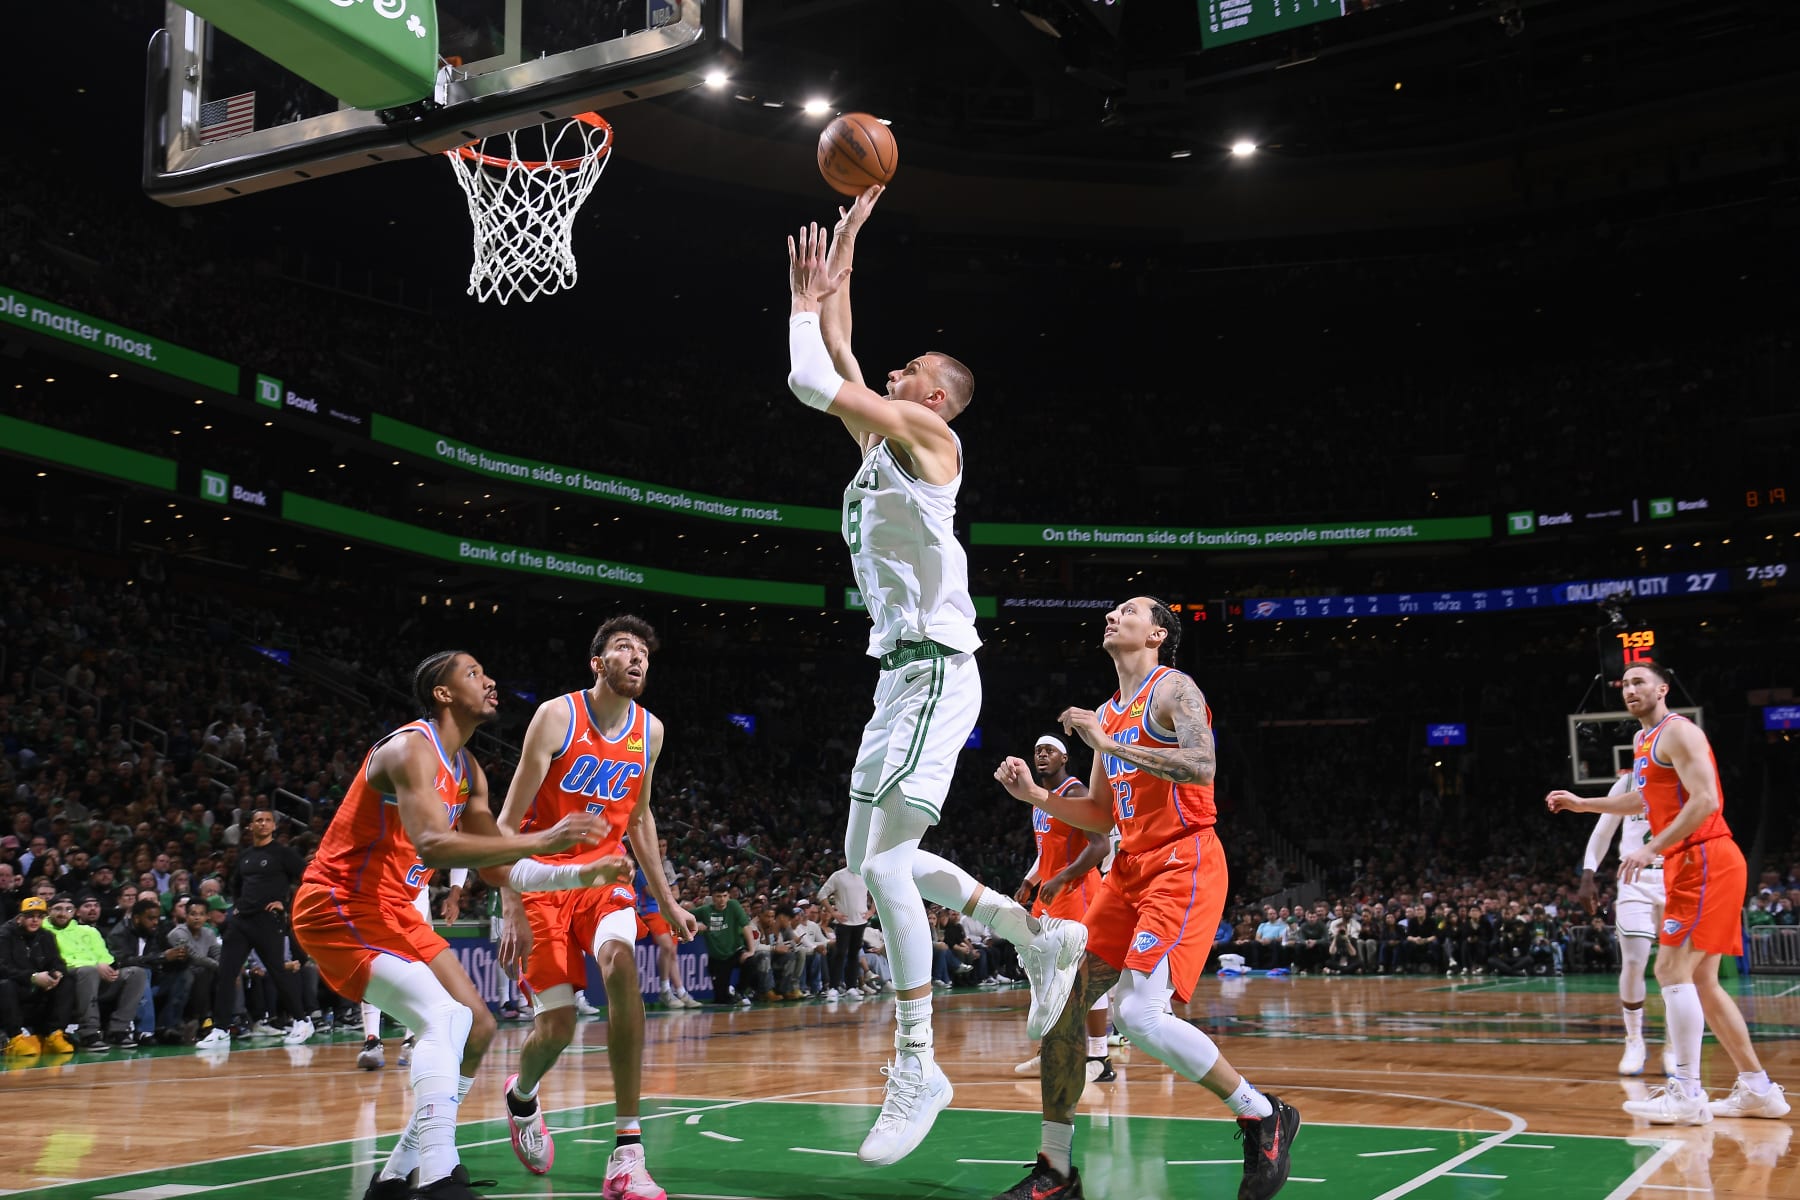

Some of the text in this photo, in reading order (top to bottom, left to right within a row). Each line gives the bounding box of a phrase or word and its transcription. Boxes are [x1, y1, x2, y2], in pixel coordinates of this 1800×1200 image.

[31, 307, 101, 342] matter
[104, 332, 157, 361] most.
[258, 379, 318, 413] TD Bank
[203, 475, 266, 506] TD Bank
[436, 440, 783, 521] On the human side of banking, people matter most.
[1512, 515, 1532, 530] TD
[1539, 512, 1573, 527] Bank
[1651, 498, 1708, 514] TD Bank
[847, 500, 862, 554] 8
[1042, 525, 1418, 545] On the human side of banking, people matter most.
[460, 542, 644, 584] Bank of the Boston Celtics
[1746, 564, 1787, 580] 7:59
[1567, 573, 1716, 601] OKLAHOMA CITY 27
[1616, 630, 1655, 648] 7:59
[560, 754, 642, 802] OKC
